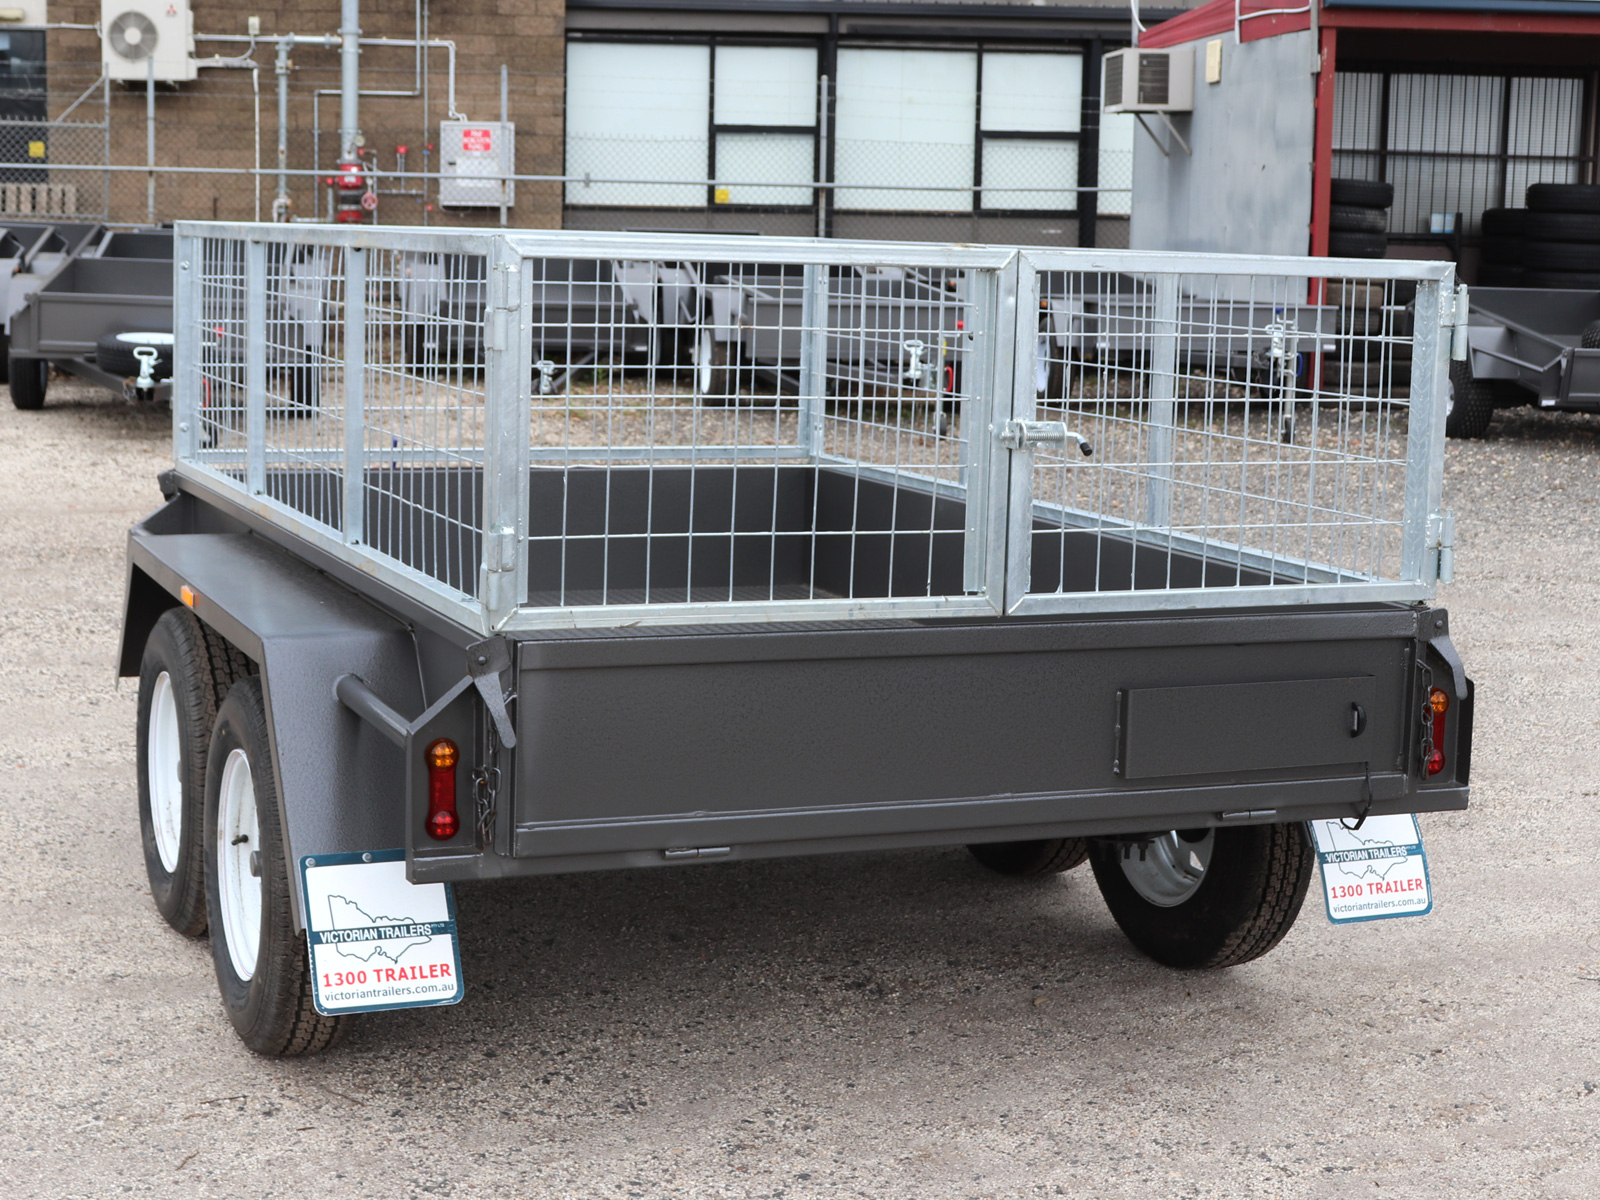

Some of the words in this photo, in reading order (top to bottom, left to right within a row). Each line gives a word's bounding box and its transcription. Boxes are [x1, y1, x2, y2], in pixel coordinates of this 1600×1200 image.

[1326, 851, 1368, 862] VICTORIAN
[1369, 846, 1407, 859] TRAILERS
[1331, 885, 1363, 898] 1300
[1367, 879, 1423, 895] TRAILER
[1334, 897, 1425, 913] victoriantrailers.com.au
[320, 928, 377, 943] VICTORIAN
[380, 924, 431, 939] TRAILERS
[323, 971, 366, 987] 1300
[373, 964, 451, 982] TRAILER
[325, 984, 454, 1001] victoriantrailers.com.au
